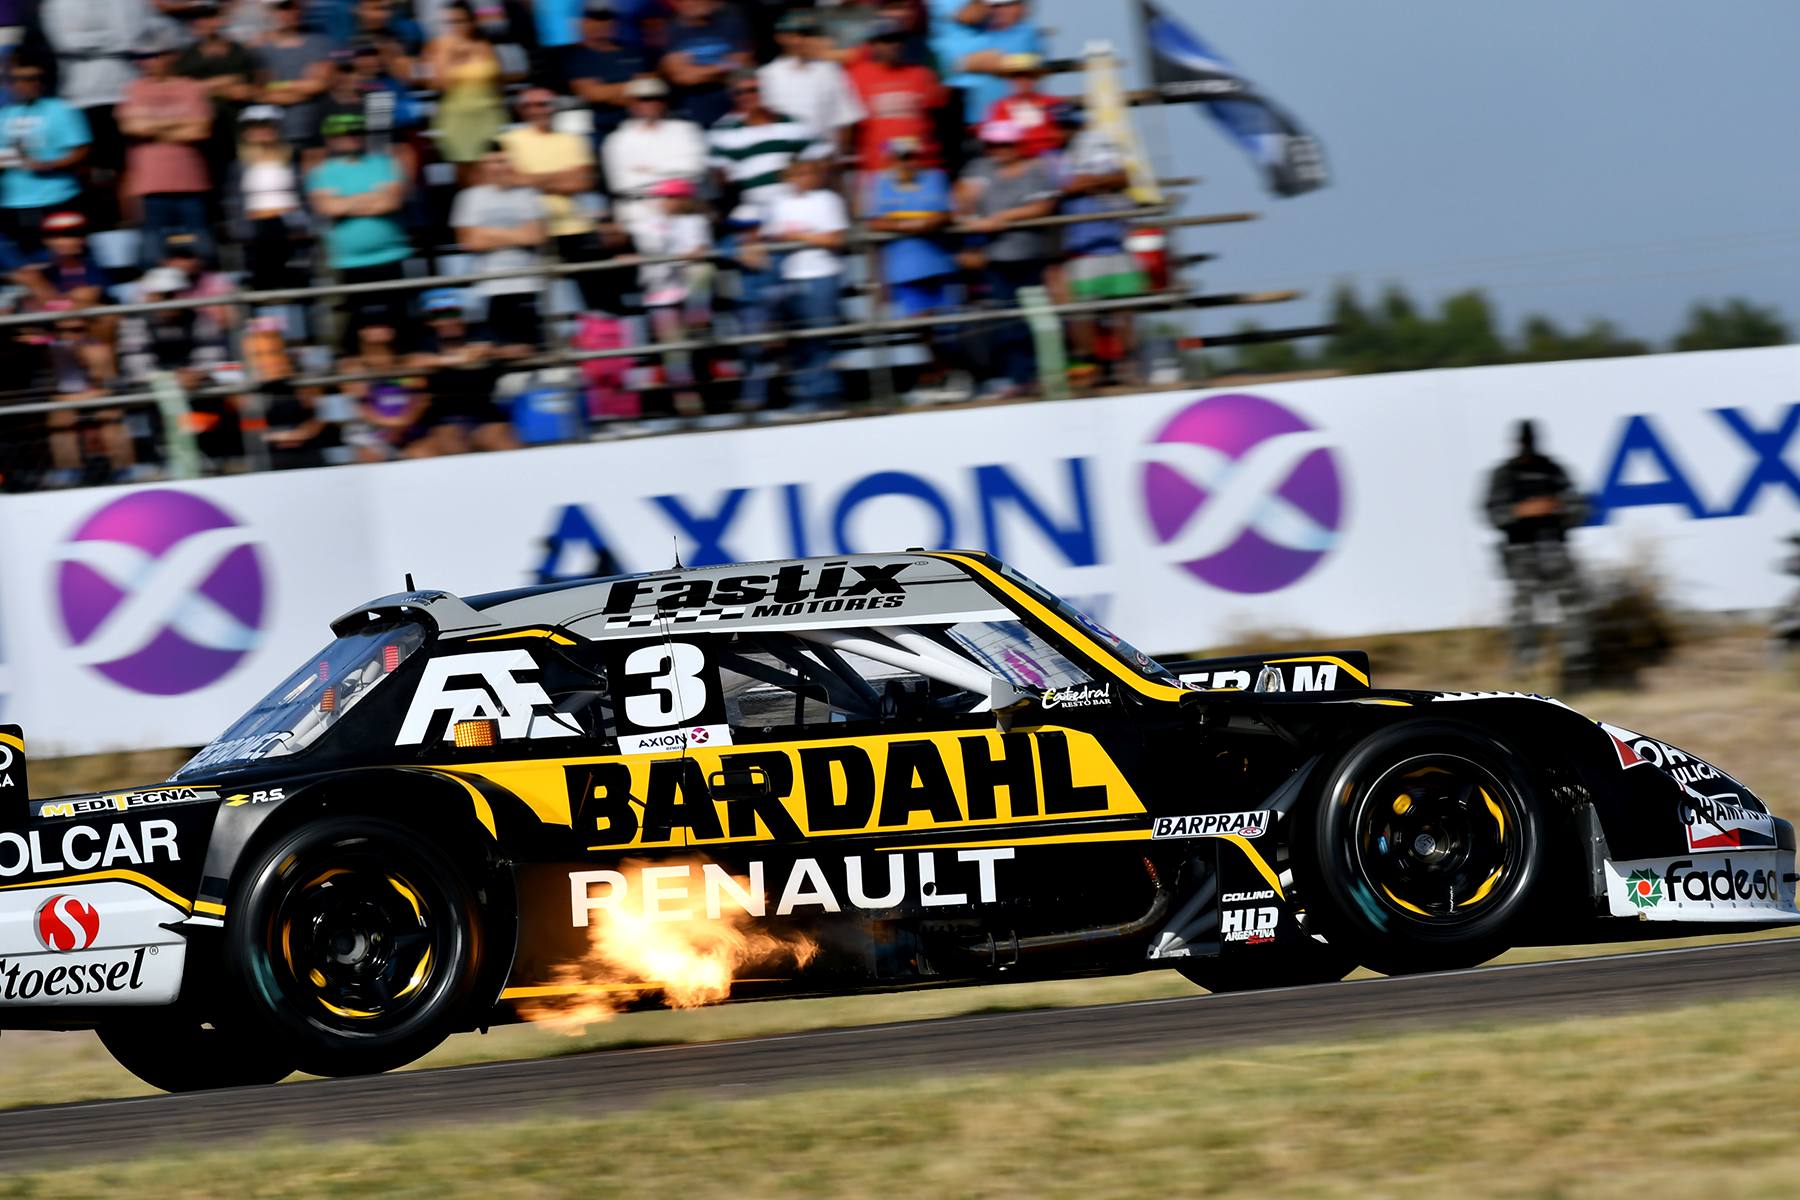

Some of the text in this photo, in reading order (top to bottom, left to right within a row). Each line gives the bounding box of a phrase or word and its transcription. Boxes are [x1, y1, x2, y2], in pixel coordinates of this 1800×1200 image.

[535, 457, 1103, 580] AXION
[602, 562, 903, 615] Fastix
[752, 595, 906, 618] MOTORES
[625, 643, 706, 727] 3
[1042, 682, 1109, 709] Catedral
[1061, 700, 1091, 709] RESTO
[639, 732, 687, 748] AXION
[41, 787, 199, 817] MEDITECNA
[564, 731, 1109, 846] BARDAHL
[1156, 812, 1264, 836] BARPRAN
[568, 847, 1015, 927] RENAULT
[1664, 858, 1777, 902] fadesa
[1222, 890, 1274, 902] COLLINO
[1221, 907, 1279, 933] HID
[1225, 929, 1275, 942] ARGENTINA
[0, 947, 146, 999] toessel
